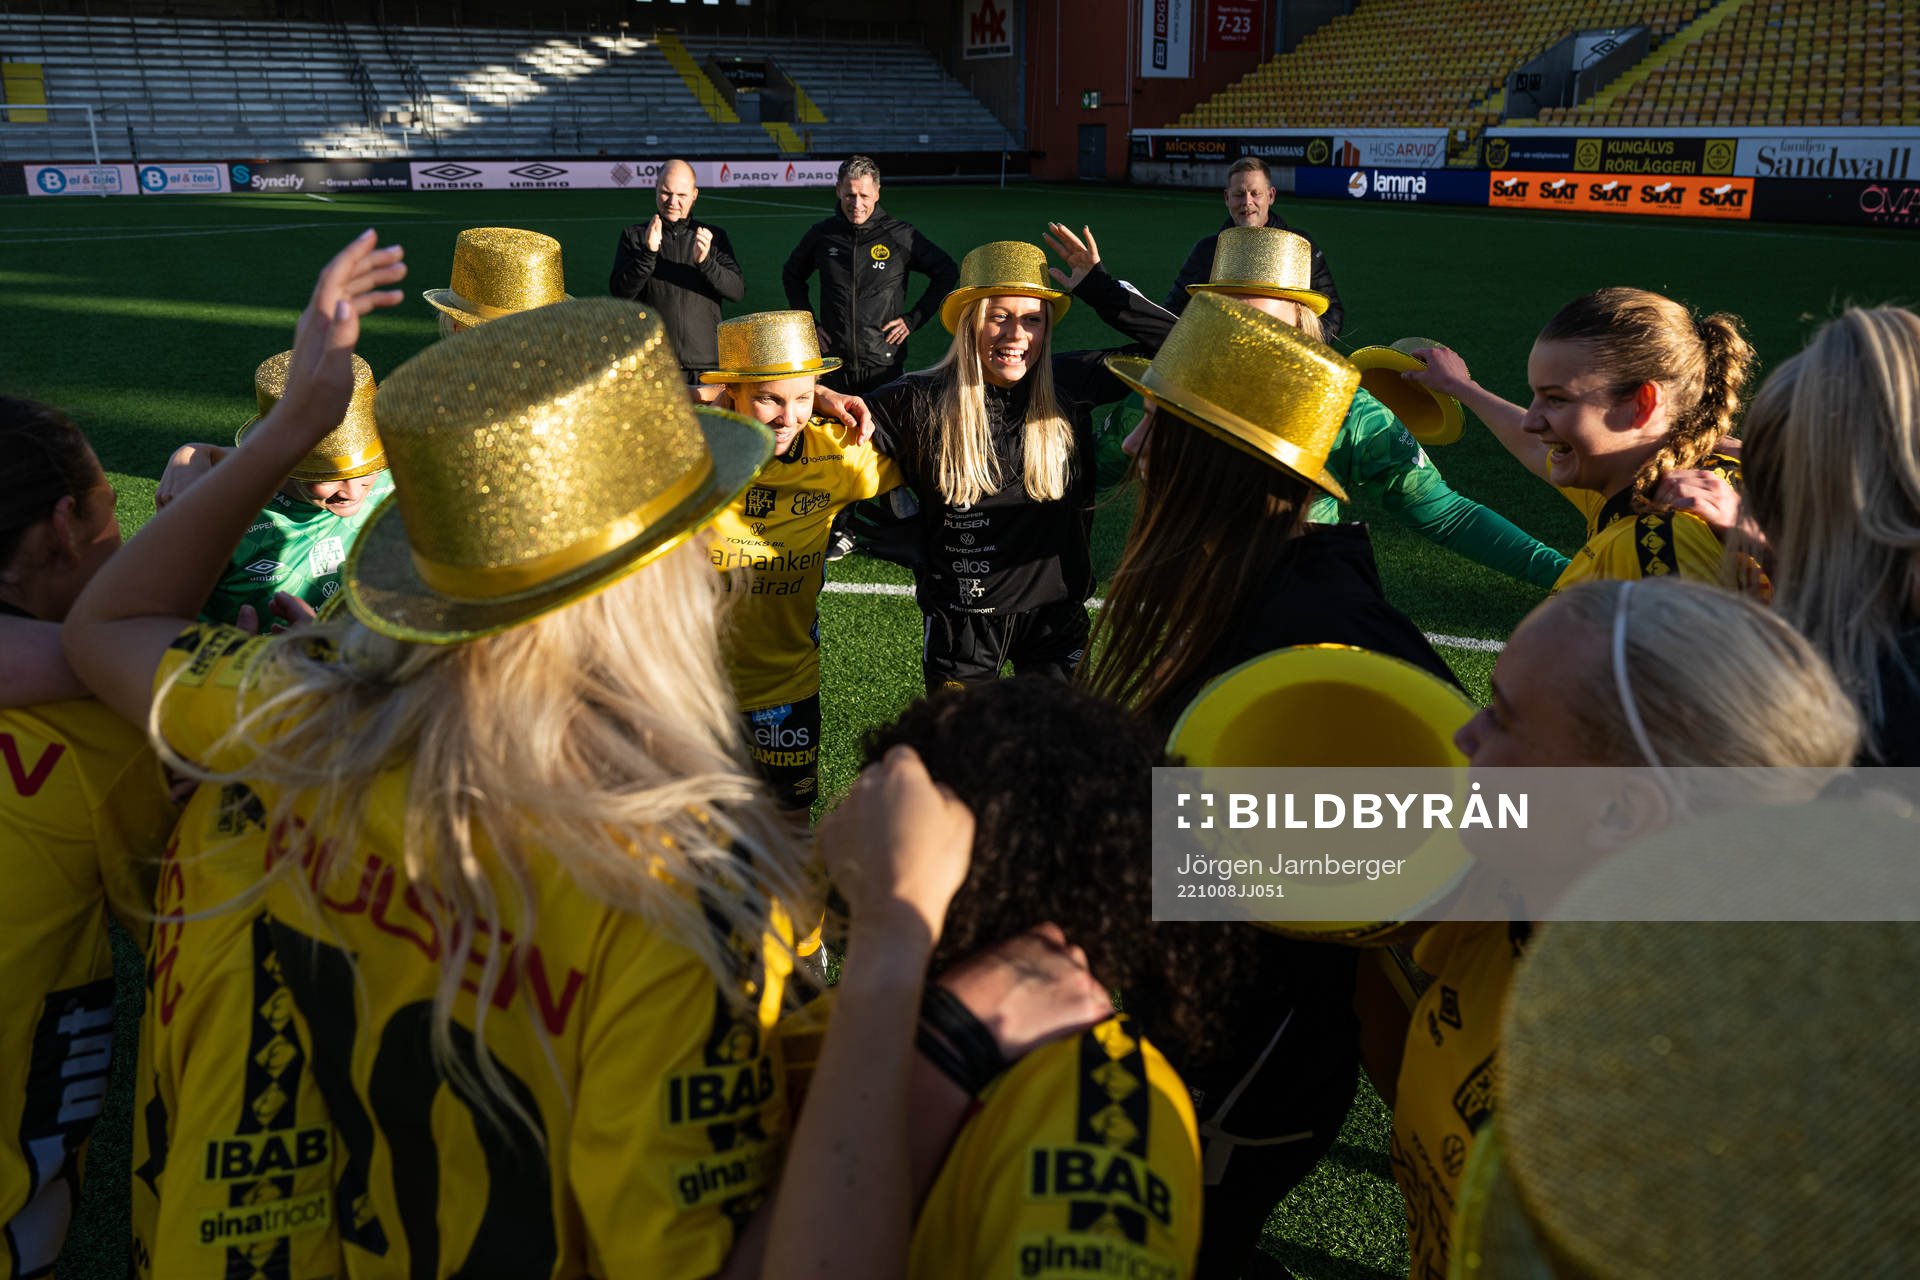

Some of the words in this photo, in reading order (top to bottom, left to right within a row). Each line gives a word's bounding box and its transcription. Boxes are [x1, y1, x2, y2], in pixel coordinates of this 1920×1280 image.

[1607, 139, 1675, 155] KUNGÄLVS
[1605, 157, 1697, 174] RÖRLÄGGERI
[1756, 146, 1911, 178] Sandwall
[251, 174, 306, 190] Syncify
[1373, 169, 1427, 194] lamina
[872, 261, 886, 270] JC
[952, 558, 990, 574] ellos
[754, 724, 810, 748] ellos
[205, 1129, 328, 1179] IBAB
[1032, 1150, 1171, 1225] IBAB
